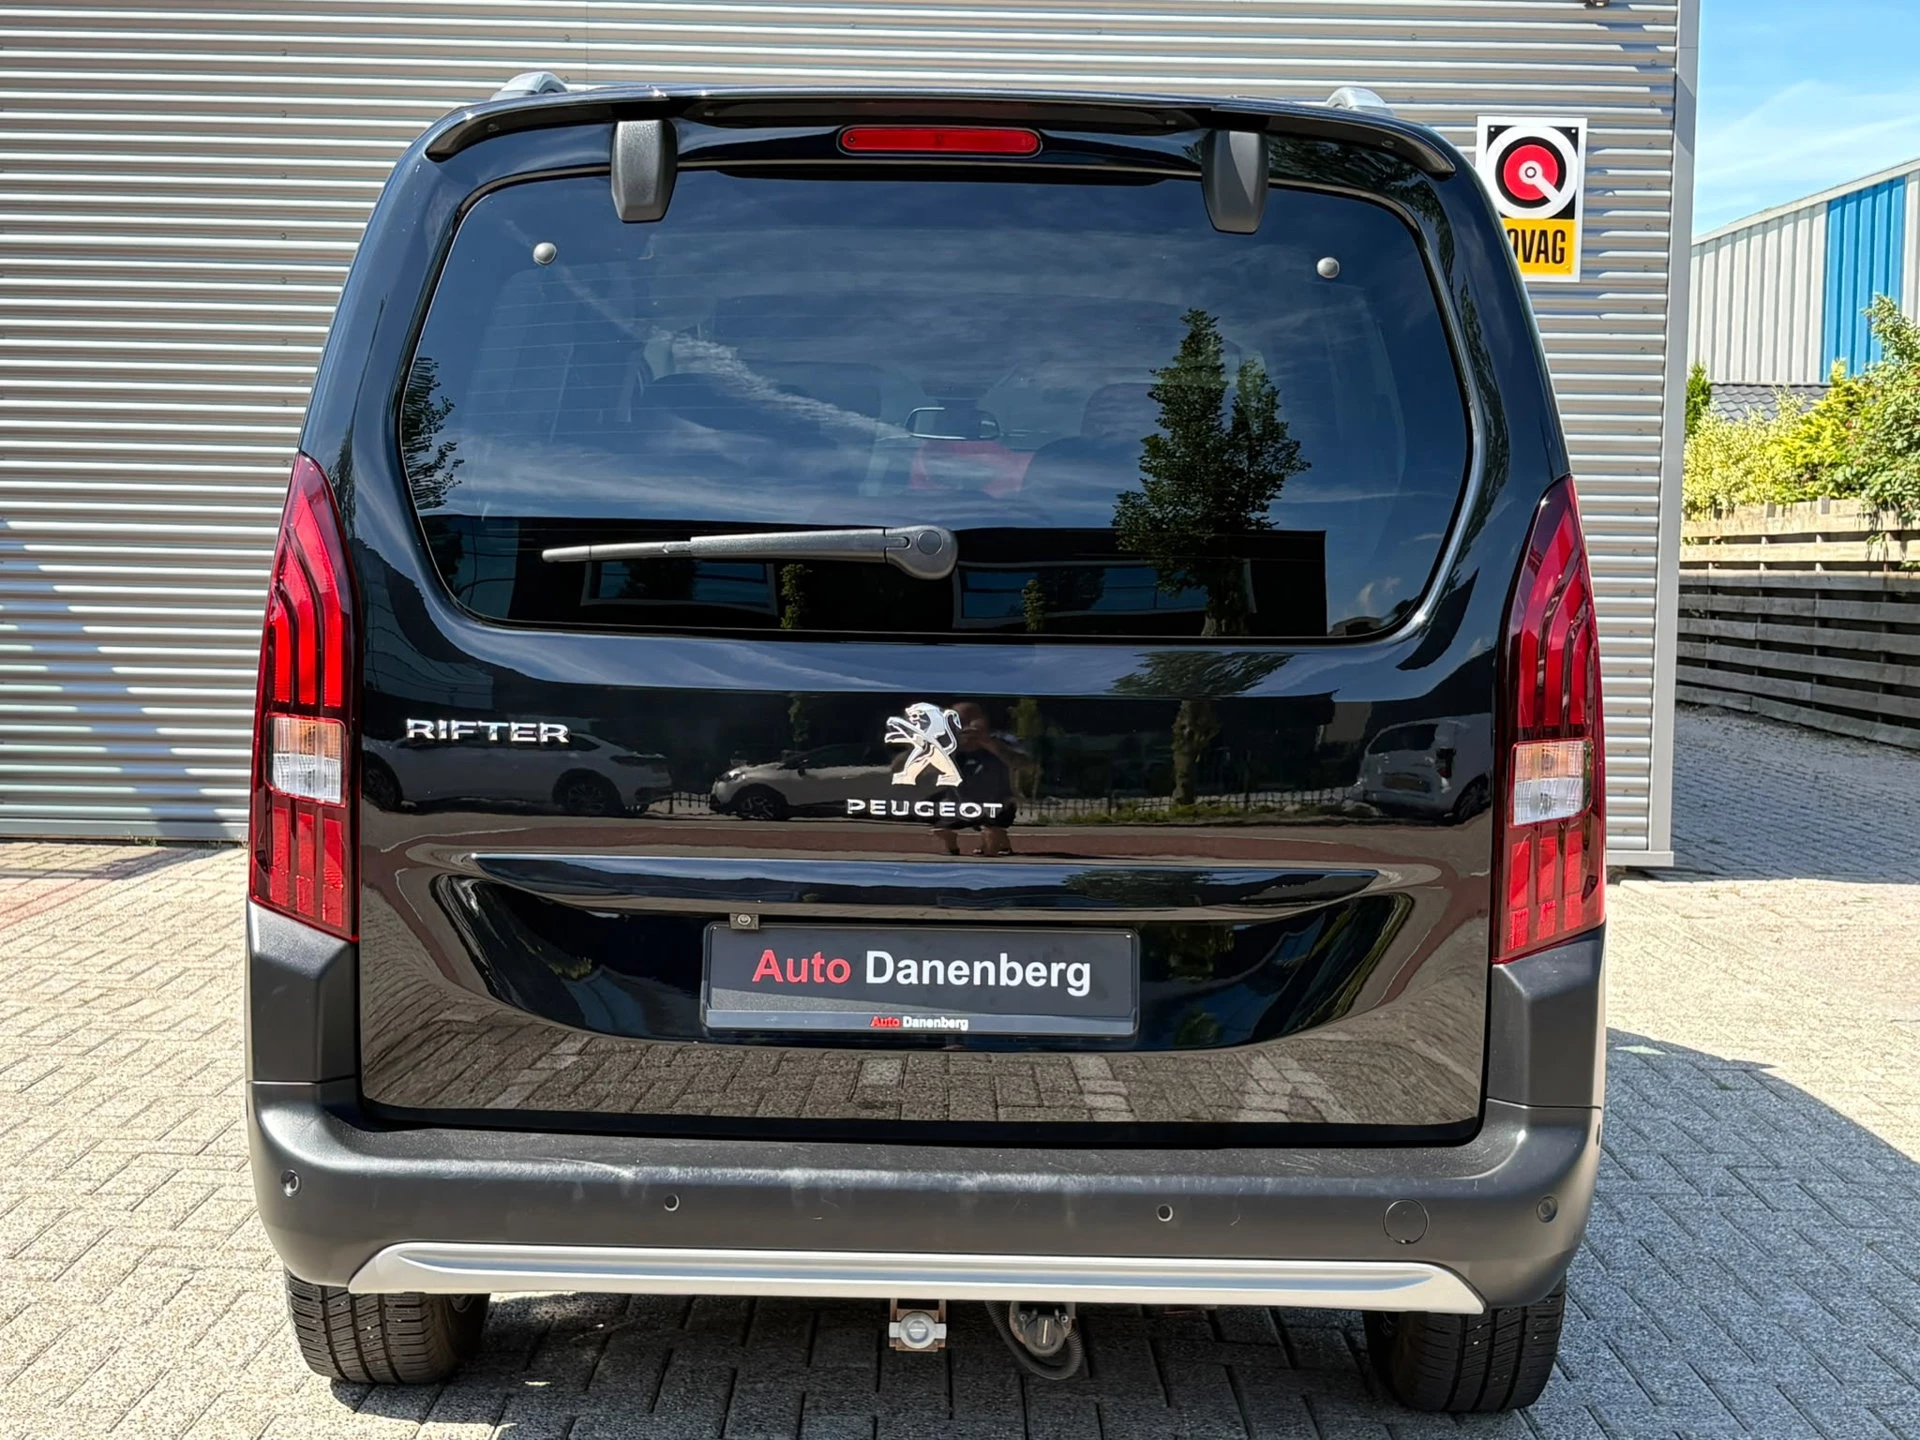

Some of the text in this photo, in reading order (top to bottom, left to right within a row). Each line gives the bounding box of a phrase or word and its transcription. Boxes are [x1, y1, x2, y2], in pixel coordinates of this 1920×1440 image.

[1506, 228, 1566, 264] OVAG
[405, 718, 570, 743] RIFTER
[847, 799, 1003, 818] PEUGEOT
[752, 949, 1091, 997] Auto Danenberg
[870, 1016, 969, 1031] Auto Danenberg
